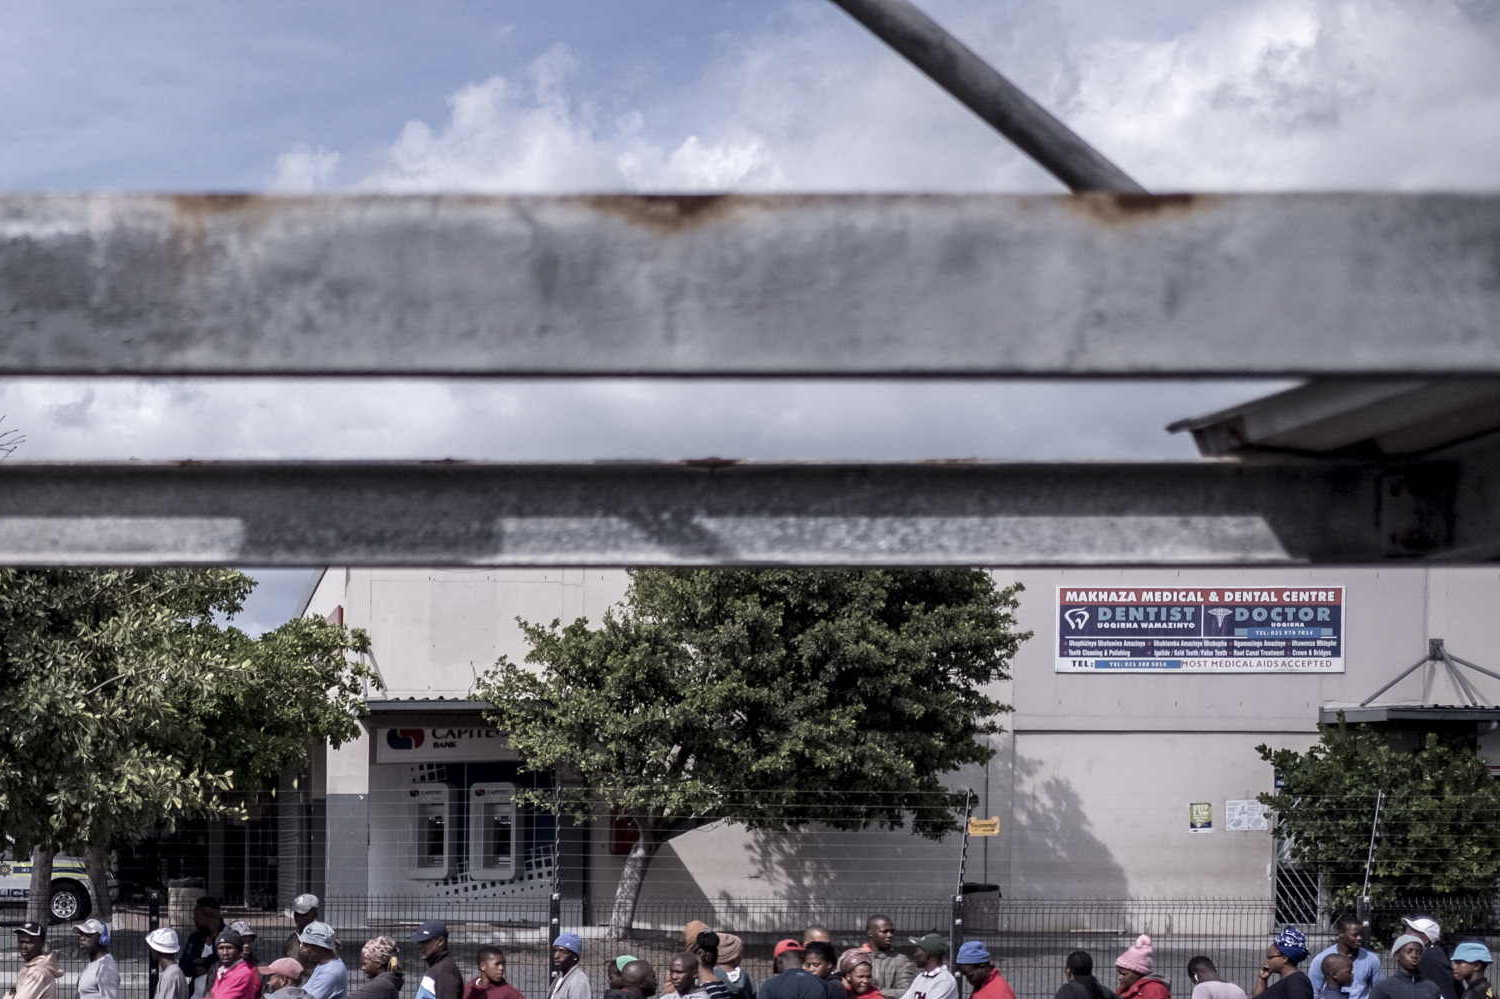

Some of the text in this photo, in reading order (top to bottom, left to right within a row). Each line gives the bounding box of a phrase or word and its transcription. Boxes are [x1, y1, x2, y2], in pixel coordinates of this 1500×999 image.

[1065, 591, 1335, 602] MAKHAZA MEDICAL & DENTAL CENTRE
[1097, 607, 1195, 621] DENTIST
[1234, 607, 1331, 621] DOCTOR
[1181, 660, 1333, 668] MOST MEDICAL AIDS ACCEPTED
[433, 741, 457, 749] BANK
